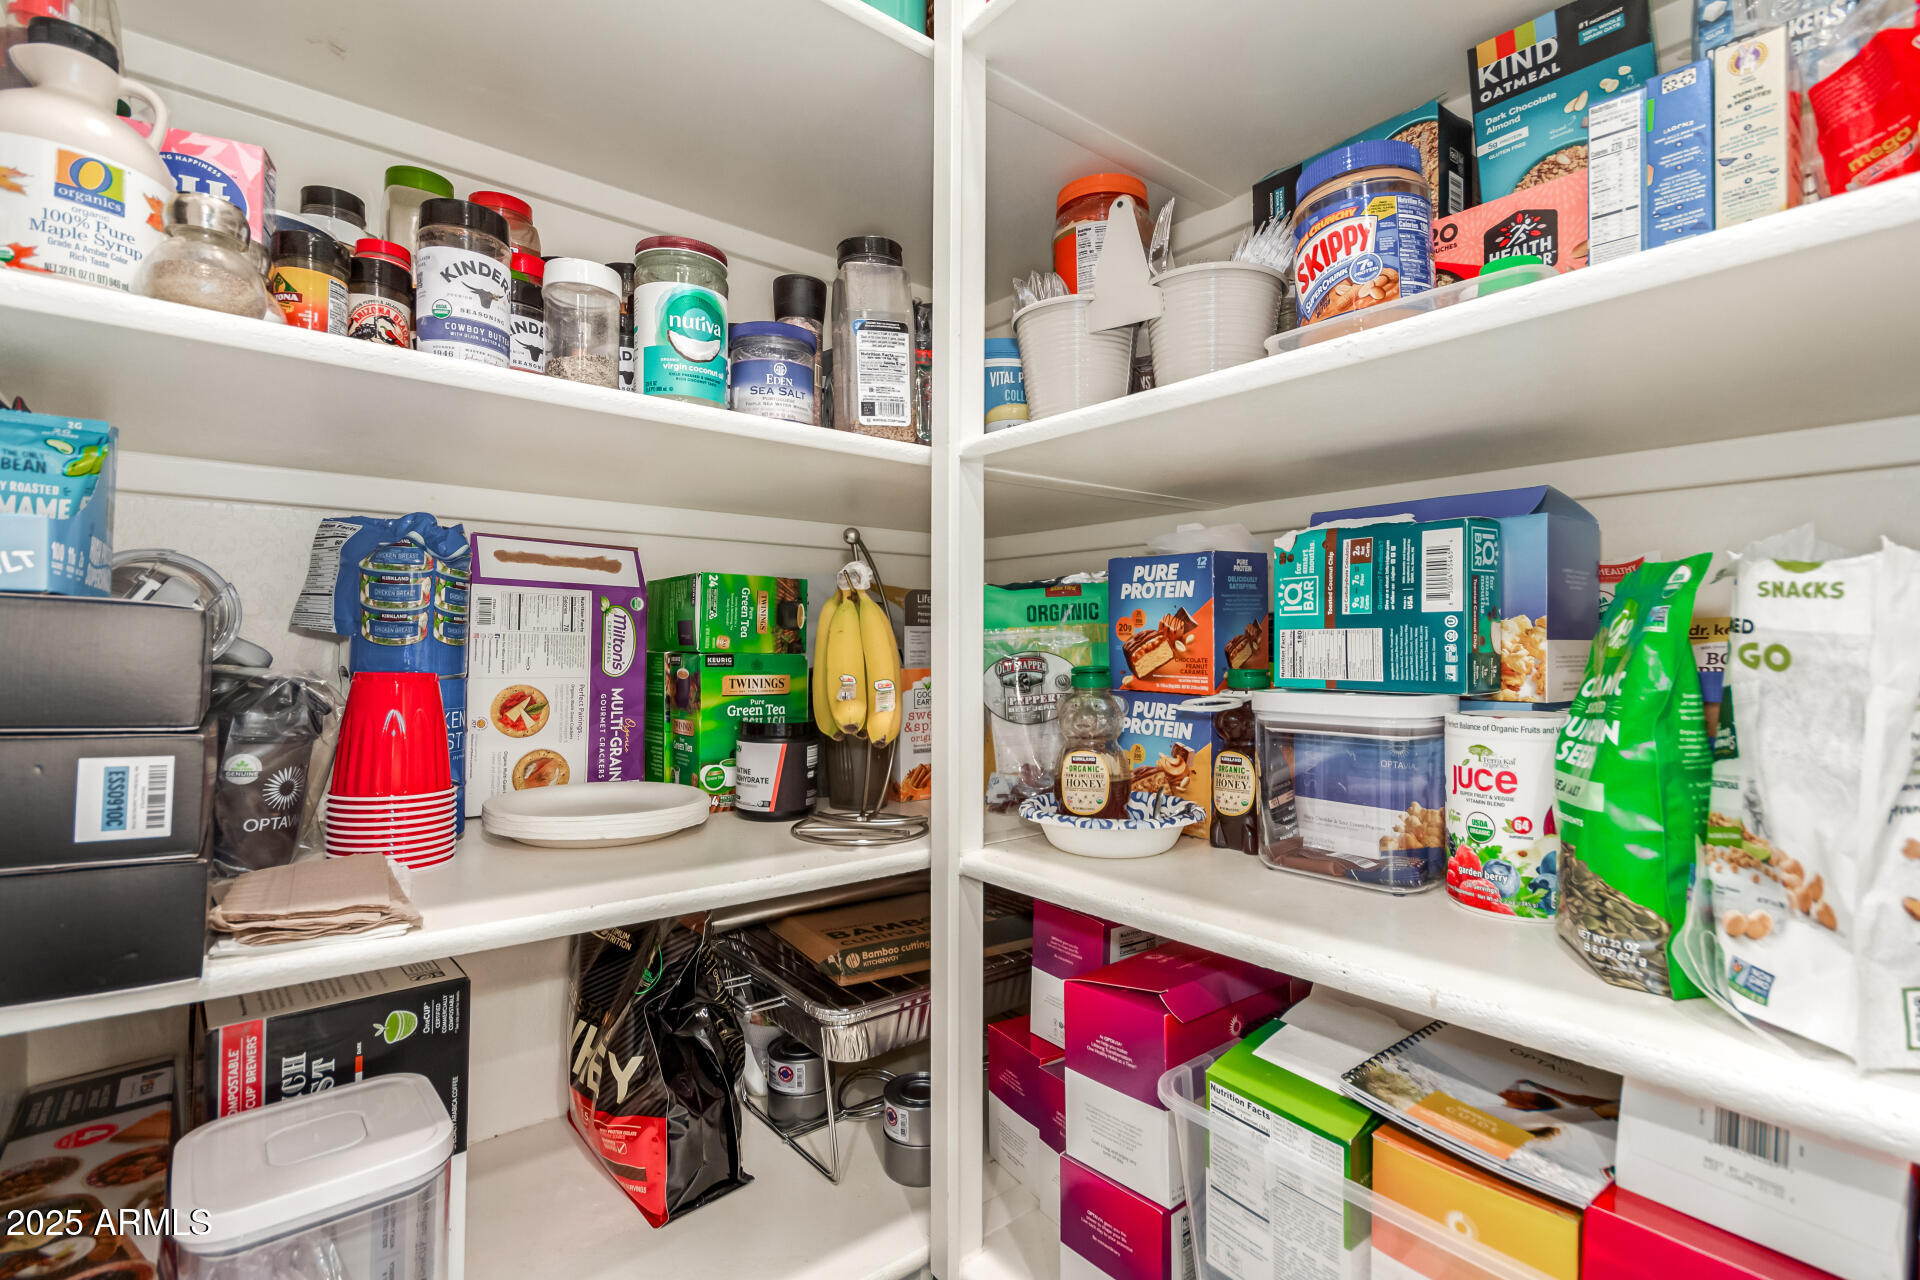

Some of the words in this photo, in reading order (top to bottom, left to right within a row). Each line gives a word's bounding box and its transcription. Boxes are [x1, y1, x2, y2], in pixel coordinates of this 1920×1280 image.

[1478, 37, 1558, 90] KIND
[1480, 63, 1561, 103] OATMEAL
[1485, 112, 1507, 126] Dark
[1508, 92, 1557, 116] Chocolate
[1486, 115, 1521, 136] Almond
[1848, 126, 1913, 173] mega
[175, 154, 223, 179] HAPPINESS
[57, 187, 122, 212] organics
[42, 207, 90, 229] 100%
[96, 220, 136, 245] Pure
[1309, 205, 1359, 237] CRUNCHY
[29, 217, 89, 241] Maple
[94, 232, 143, 261] Syrup
[1489, 235, 1553, 263] HEALTH
[47, 236, 72, 249] Grade
[75, 243, 81, 251] A
[83, 245, 108, 258] Amber
[110, 252, 129, 265] Color
[69, 251, 88, 264] Rich
[91, 256, 111, 269] Taste
[1297, 223, 1371, 295] SKIPPY
[354, 306, 391, 323] ARIZONA
[392, 313, 409, 345] BLACK
[460, 307, 506, 326] SEASONING
[669, 314, 721, 338] nutiva
[444, 321, 486, 336] COWBOY
[663, 362, 688, 372] virgin
[689, 365, 718, 377] coconut
[990, 371, 1016, 388] VITAL
[766, 374, 793, 387] EDEN
[750, 385, 775, 395] SEA
[778, 386, 807, 400] SALT
[67, 421, 83, 430] 2G
[1, 455, 48, 475] BEAN
[9, 480, 60, 495] ROASTED
[1327, 551, 1335, 566] Chip
[1474, 532, 1483, 567] BAR
[1482, 533, 1496, 566] IQ
[1196, 556, 1208, 566] 12
[708, 574, 719, 588] 24
[1133, 562, 1180, 582] PURE
[1120, 580, 1194, 600] PROTEIN
[1282, 582, 1304, 612] IQ
[1302, 580, 1315, 611] BAR
[1757, 580, 1845, 600] SNACKS
[741, 587, 751, 618] Green
[1026, 602, 1099, 622] ORGANIC
[1406, 594, 1414, 610] USA
[740, 619, 750, 638] Tea
[1118, 622, 1132, 632] 20g
[1689, 624, 1710, 636] dr.
[612, 612, 627, 672] Milton's
[707, 656, 733, 664] KEURIG
[1738, 642, 1793, 673] GO
[728, 676, 787, 690] TWININGS
[727, 704, 762, 718] Green
[765, 704, 786, 716] Tea
[750, 698, 765, 706] Pure
[1133, 700, 1179, 721] PURE
[608, 687, 625, 783] MULTI-GRAIN
[624, 718, 637, 754] Organic
[1121, 717, 1194, 741] PROTEIN
[1459, 721, 1481, 731] Balance
[1482, 723, 1489, 732] of
[1490, 723, 1519, 735] Organic
[1520, 725, 1541, 735] Fruits
[1542, 726, 1555, 735] and
[598, 735, 606, 780] CRACKERS
[1380, 759, 1416, 769] OPTAVIA
[225, 770, 259, 778] GENUINE
[1069, 765, 1101, 773] ORGANIC
[1218, 765, 1246, 775] ORGANIC
[1066, 778, 1104, 789] HONEY
[1215, 777, 1250, 790] HONEY
[1466, 798, 1485, 806] VITAMIN
[1486, 800, 1505, 808] BLEND
[1473, 791, 1488, 799] FRUIT
[1494, 795, 1515, 803] VEGGIE
[1471, 818, 1488, 827] USDA
[1513, 820, 1530, 832] 64
[1458, 866, 1482, 877] garden
[1484, 870, 1508, 884] berry
[862, 946, 900, 960] Bamboo
[901, 940, 930, 952] cutting
[1592, 933, 1607, 945] WT
[1609, 938, 1621, 949] 22
[1623, 940, 1641, 954] OZ
[863, 955, 899, 968] KITCHENVOY
[245, 1034, 258, 1083] BREWERS
[1509, 1047, 1588, 1085] OPTAVIA
[1210, 1082, 1246, 1108] Nutrition
[1246, 1100, 1271, 1121] Facts
